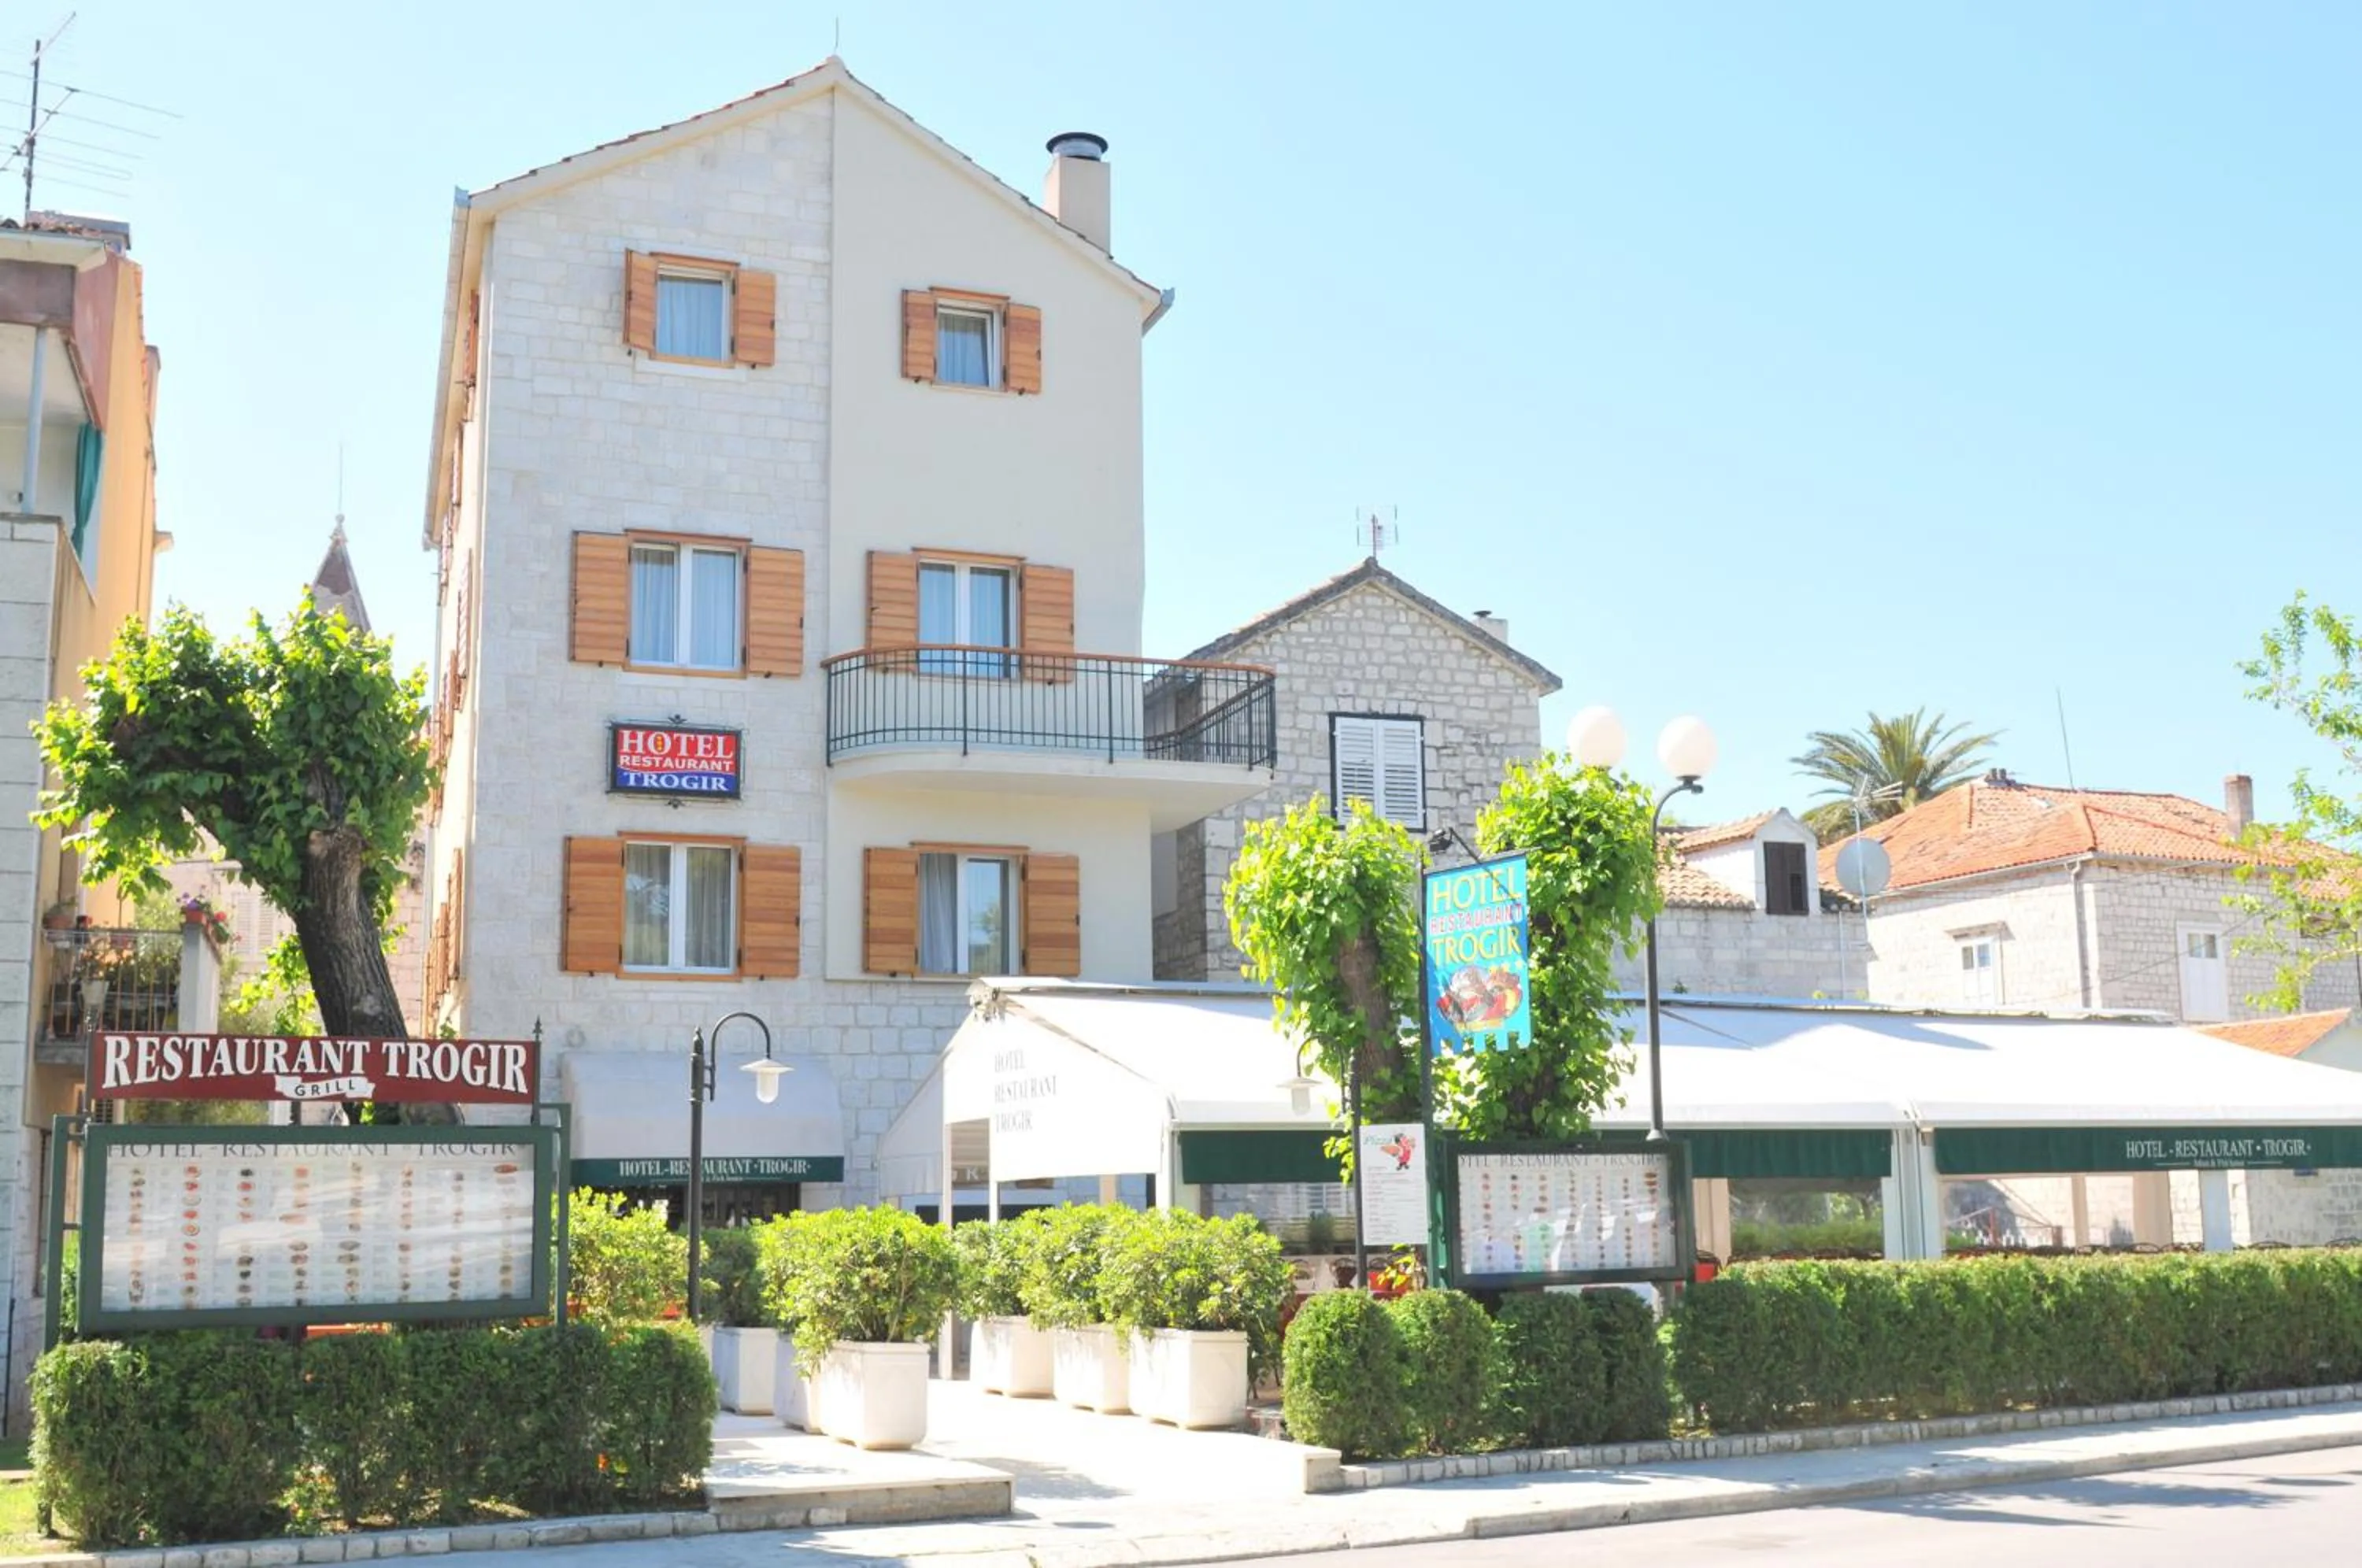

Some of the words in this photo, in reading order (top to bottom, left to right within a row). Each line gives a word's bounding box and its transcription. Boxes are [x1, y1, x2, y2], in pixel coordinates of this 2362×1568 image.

[620, 730, 734, 759] HOTEL
[620, 755, 734, 772] RESTAURANT
[624, 772, 729, 792] TROGIR
[1431, 867, 1523, 914] HOTEL
[1430, 903, 1523, 934] RESTAURANT
[1432, 926, 1522, 967] TROGIR
[102, 1035, 370, 1089] RESTAURANT
[382, 1042, 528, 1094] TROGIR
[994, 1049, 1026, 1073] HOTEL
[294, 1078, 355, 1096] GRILL
[994, 1075, 1057, 1104] RESTAURANT
[995, 1110, 1033, 1133] TROGIR
[2126, 1141, 2167, 1159] HOTEL
[2175, 1140, 2254, 1157] RESTAURANT
[2263, 1139, 2306, 1156] TROGIR
[619, 1159, 664, 1177] HOTEL
[669, 1158, 753, 1175] RESAURANT
[758, 1159, 809, 1174] TROGIR
